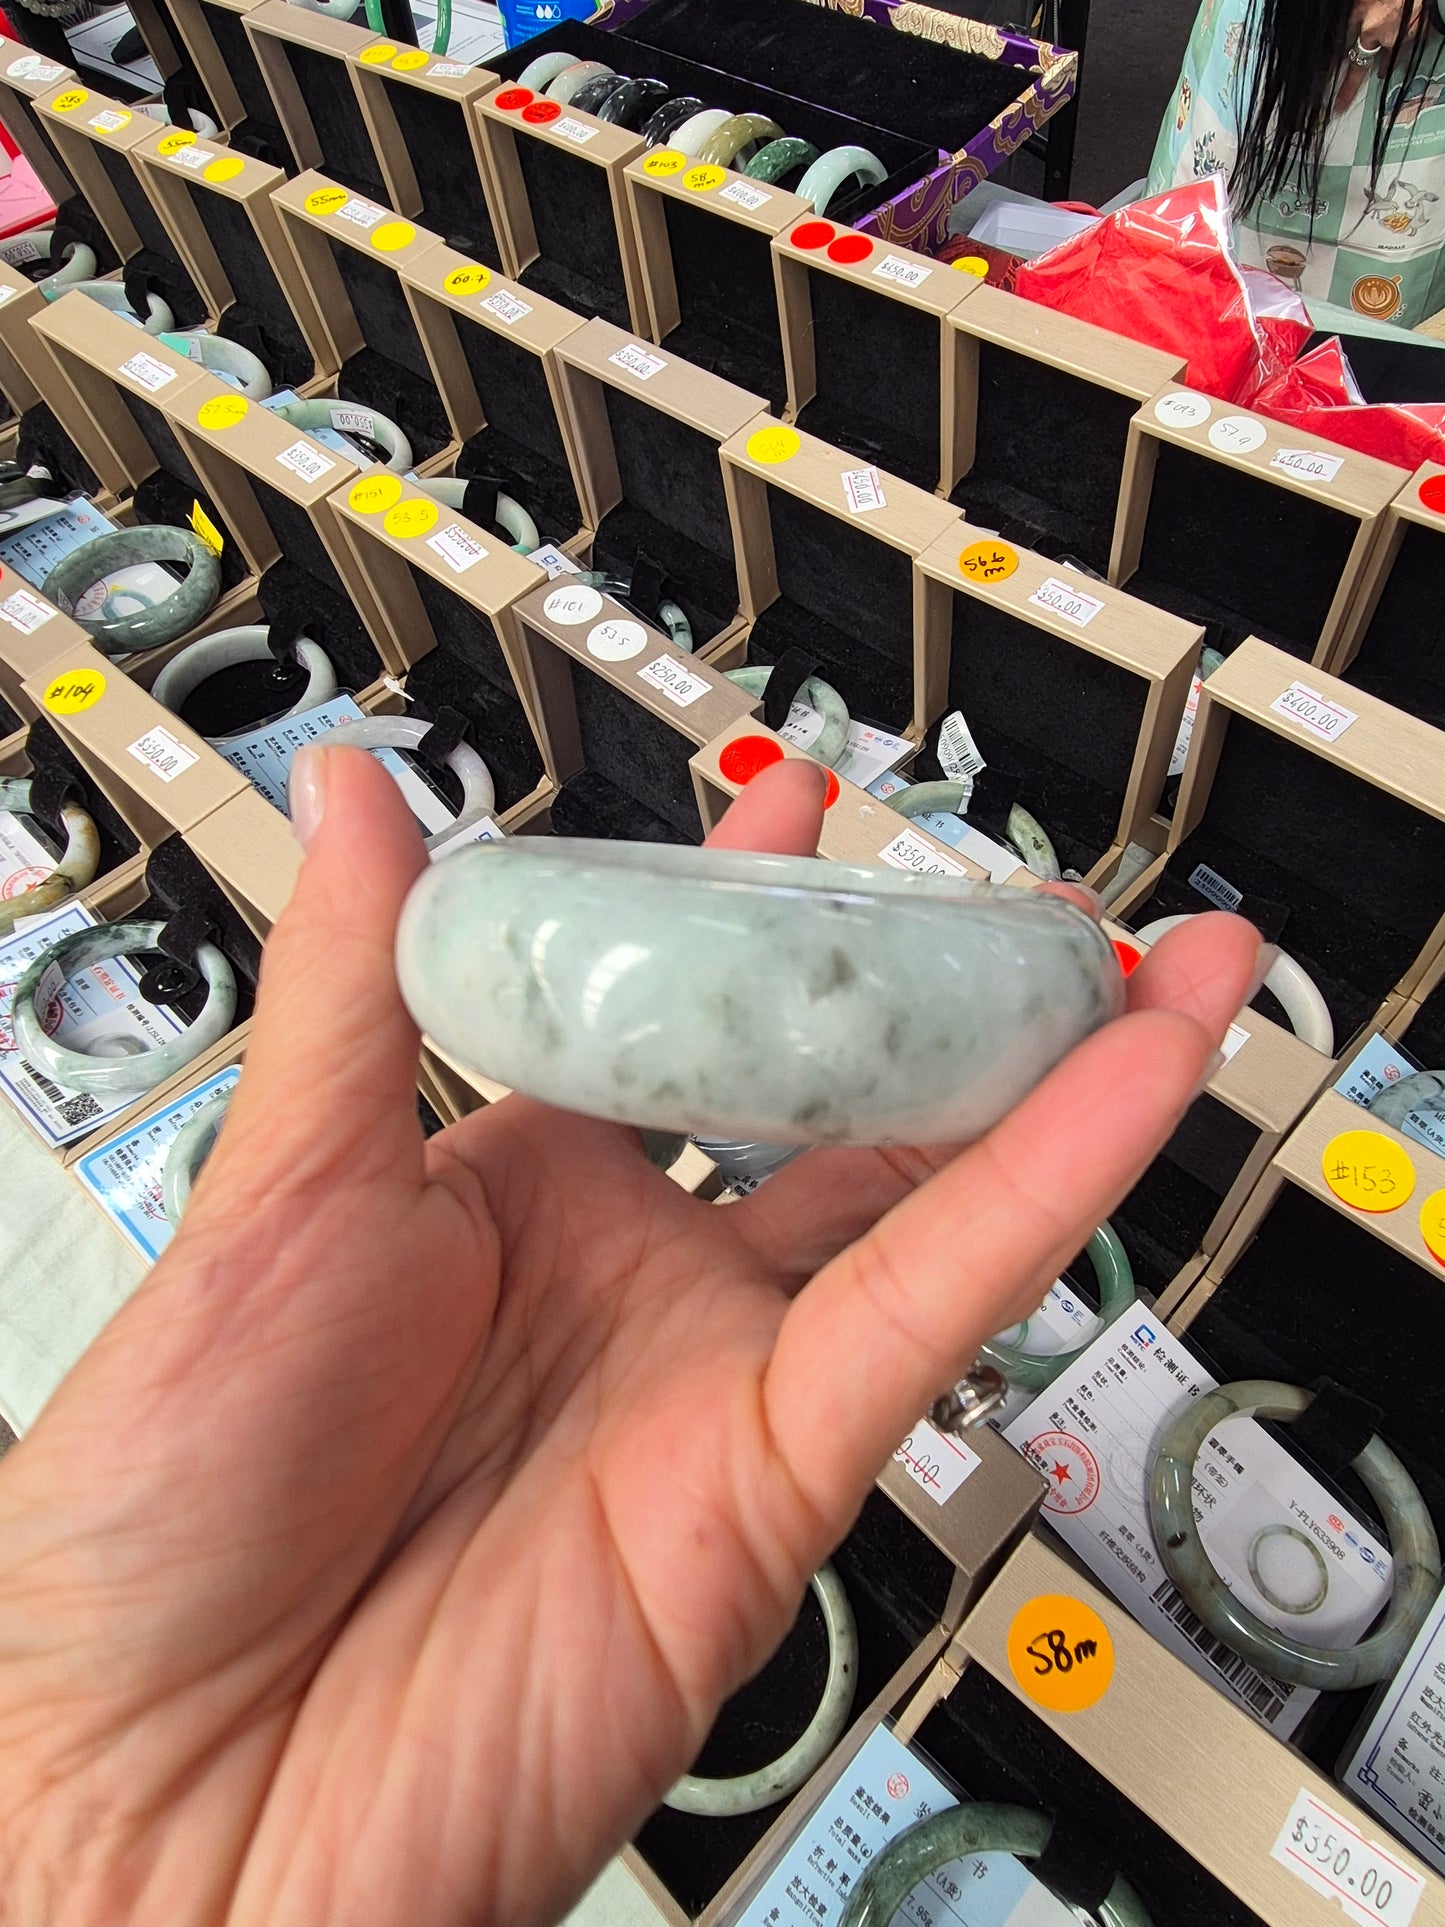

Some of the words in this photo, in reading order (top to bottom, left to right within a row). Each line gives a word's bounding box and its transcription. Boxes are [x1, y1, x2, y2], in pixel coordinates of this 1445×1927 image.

[648, 161, 678, 169] #103
[691, 172, 707, 182] 58
[728, 186, 759, 204] $400.00
[452, 274, 487, 285] 60.7
[880, 261, 919, 282] $450.00
[616, 350, 650, 375] $350.00
[340, 414, 373, 430] $350.00
[287, 448, 321, 475] $350.00
[353, 489, 383, 501] #151
[852, 469, 874, 504] $450.00
[548, 598, 583, 612] #101
[1034, 588, 1082, 615] $350.00
[649, 661, 693, 694] $250.00
[48, 683, 96, 703] #104
[1282, 691, 1339, 731] $400.00
[138, 737, 178, 771] $350.00
[90, 960, 126, 1001] 石鉴定证书
[1330, 1160, 1396, 1195] #153
[1130, 1334, 1145, 1351] NGTC
[1153, 1346, 1201, 1398] 检测证书
[1207, 1435, 1244, 1476] 翡翠手镯
[1287, 1500, 1347, 1560] Y-PLY633908
[1097, 1529, 1147, 1583] 纤维交织结构
[1408, 1710, 1445, 1747] 红外光
[848, 1796, 871, 1819] Result
[854, 1786, 892, 1825] 鉴定结果
[827, 1826, 846, 1846] Total
[805, 1855, 836, 1887] Refractive
[1291, 1816, 1393, 1910] $350.00
[789, 1875, 829, 1916] 放大检查
